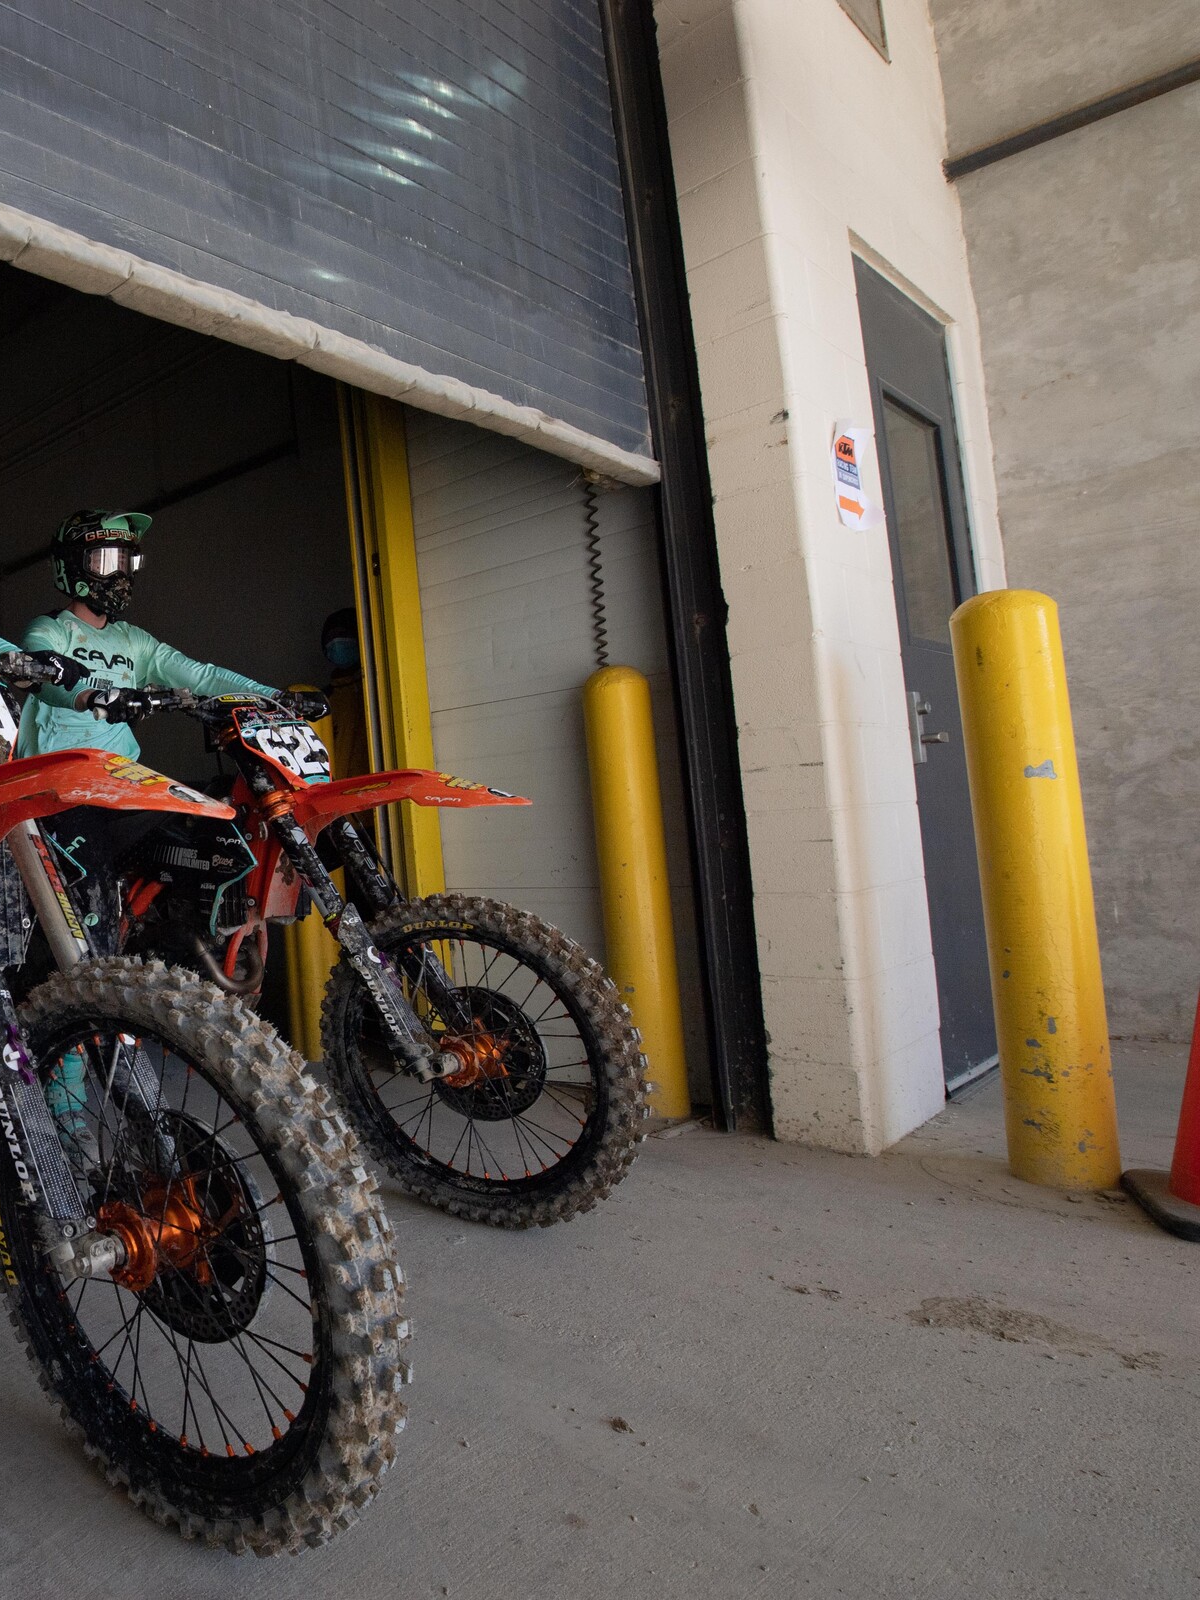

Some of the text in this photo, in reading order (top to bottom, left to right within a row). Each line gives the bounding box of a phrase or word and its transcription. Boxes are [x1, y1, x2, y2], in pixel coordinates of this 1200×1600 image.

[838, 442, 853, 457] KTM
[256, 724, 330, 776] 625
[56, 891, 85, 940] ACTIVE
[402, 920, 474, 933] DUNLOP
[360, 966, 402, 1036] DUNLOP
